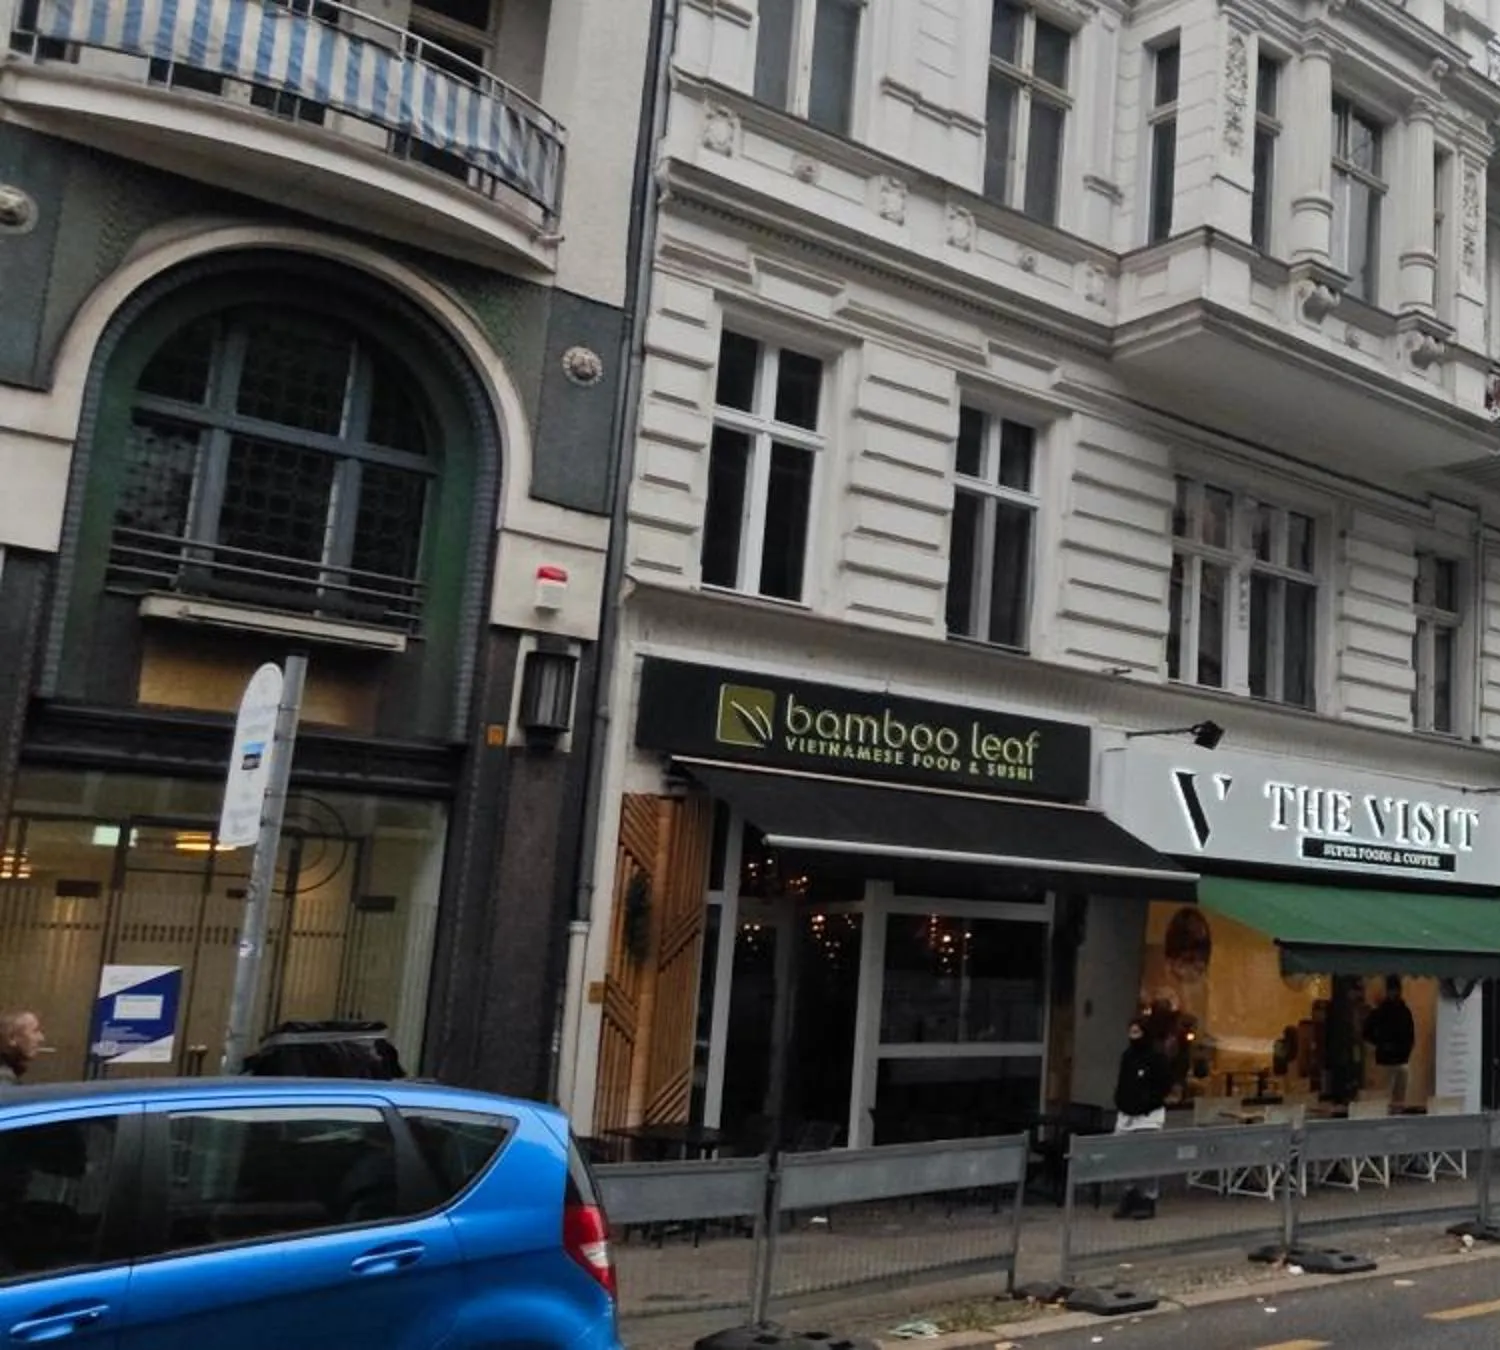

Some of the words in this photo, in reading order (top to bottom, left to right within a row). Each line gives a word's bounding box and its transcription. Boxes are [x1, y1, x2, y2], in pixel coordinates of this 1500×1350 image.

[785, 735, 905, 766] VIETNAMESE
[912, 753, 961, 772] FOOD
[968, 761, 980, 775] &
[987, 763, 1034, 782] SUSHI
[786, 693, 959, 755] bamboo
[971, 721, 1041, 766] leaf
[1264, 780, 1353, 836] THE
[1363, 794, 1480, 851] VISIT
[1358, 847, 1393, 861] FOODS
[1403, 853, 1441, 867] COFFEE
